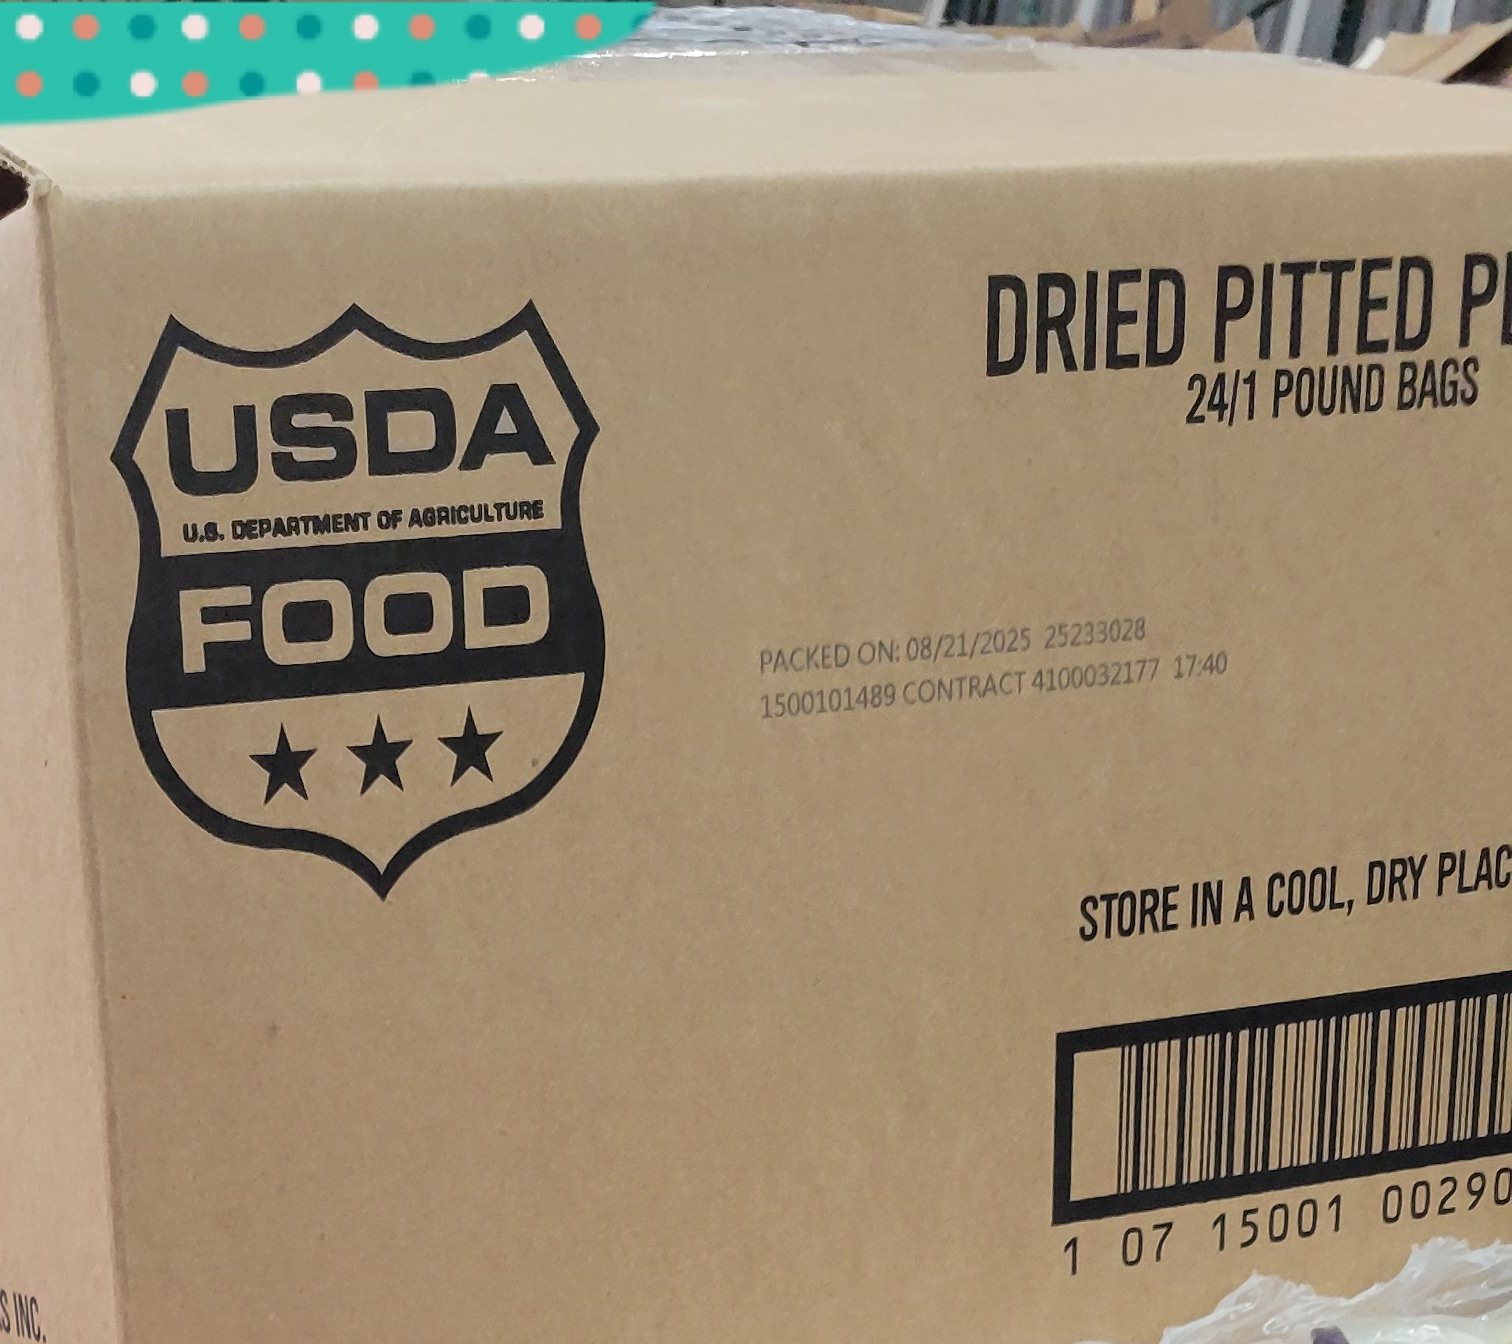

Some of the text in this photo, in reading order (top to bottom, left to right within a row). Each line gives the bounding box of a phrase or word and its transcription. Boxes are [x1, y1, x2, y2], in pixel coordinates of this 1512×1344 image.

[987, 267, 1186, 377] DRIED
[1214, 255, 1434, 363] PITTED
[1187, 356, 1480, 427] 24/1 POUND BAGS
[165, 383, 556, 497] USDA
[182, 498, 545, 544] U.S. DEPARTMENT OF AGRICULTURE
[178, 564, 551, 675] FOOD
[759, 616, 1148, 675] PACKED ON: 08/21/2025 25233028
[759, 650, 1230, 720] 1500101489 CONTRACT 4100032177 17:40
[1079, 884, 1180, 942] STORE
[1191, 880, 1223, 929] IN
[1233, 876, 1256, 922] A
[1266, 864, 1355, 919] COOL,
[1367, 854, 1428, 906] DRY
[1062, 1236, 1080, 1277] 1
[1120, 1221, 1175, 1268] 07
[1210, 1194, 1343, 1254] 15001
[12, 1291, 47, 1344] INC.
